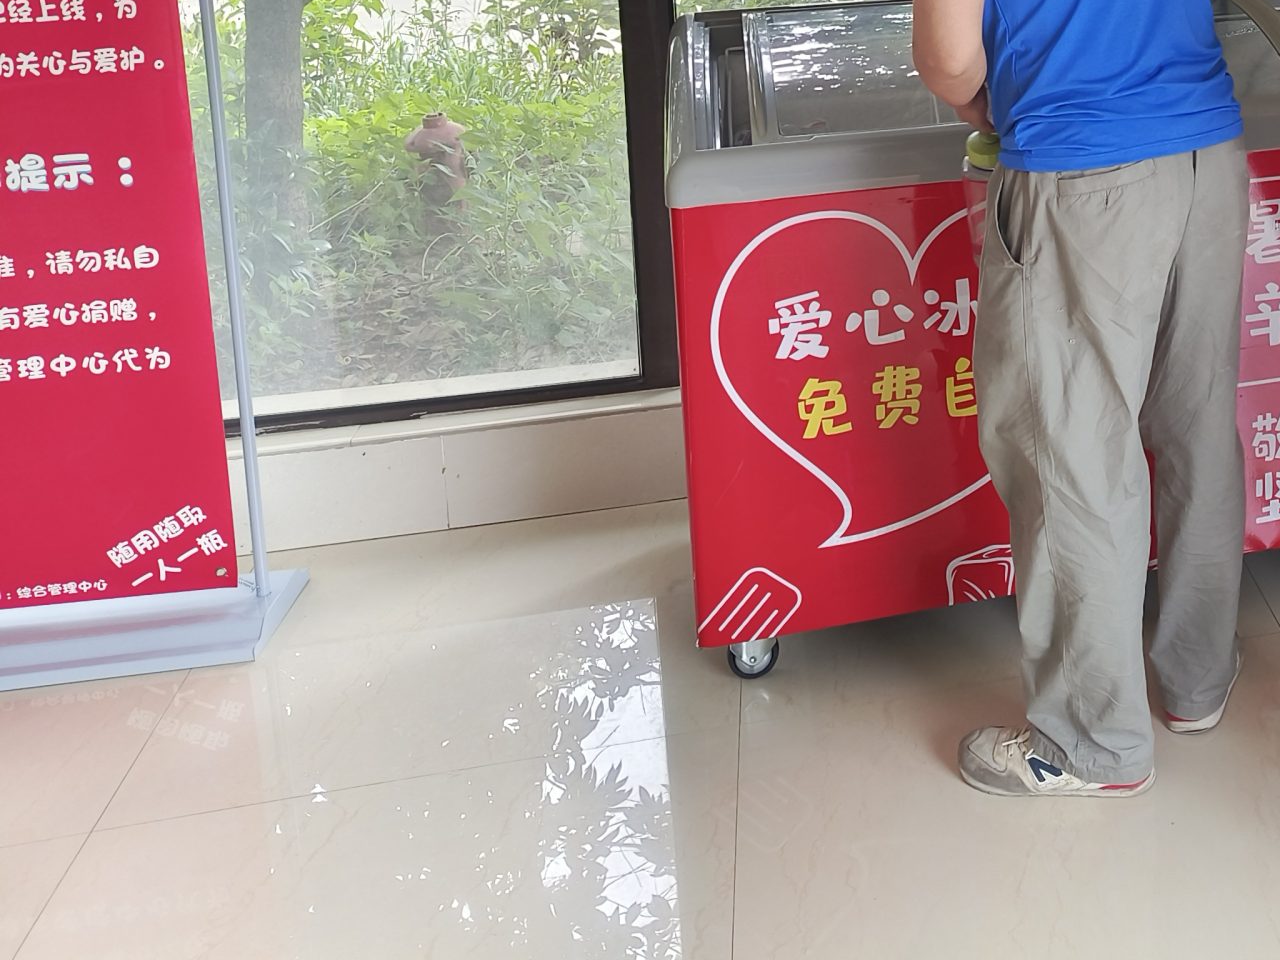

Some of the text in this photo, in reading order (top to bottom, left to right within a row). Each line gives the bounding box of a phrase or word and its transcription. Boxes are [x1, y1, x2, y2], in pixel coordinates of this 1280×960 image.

[0, 153, 134, 192] 提示：
[0, 297, 157, 331] 有爱心捐赠，
[768, 278, 977, 360] 爱心冰
[106, 504, 207, 568] 随用随取
[131, 528, 228, 588] 一人一瓶
[0, 579, 108, 600] ：综合管理中心
